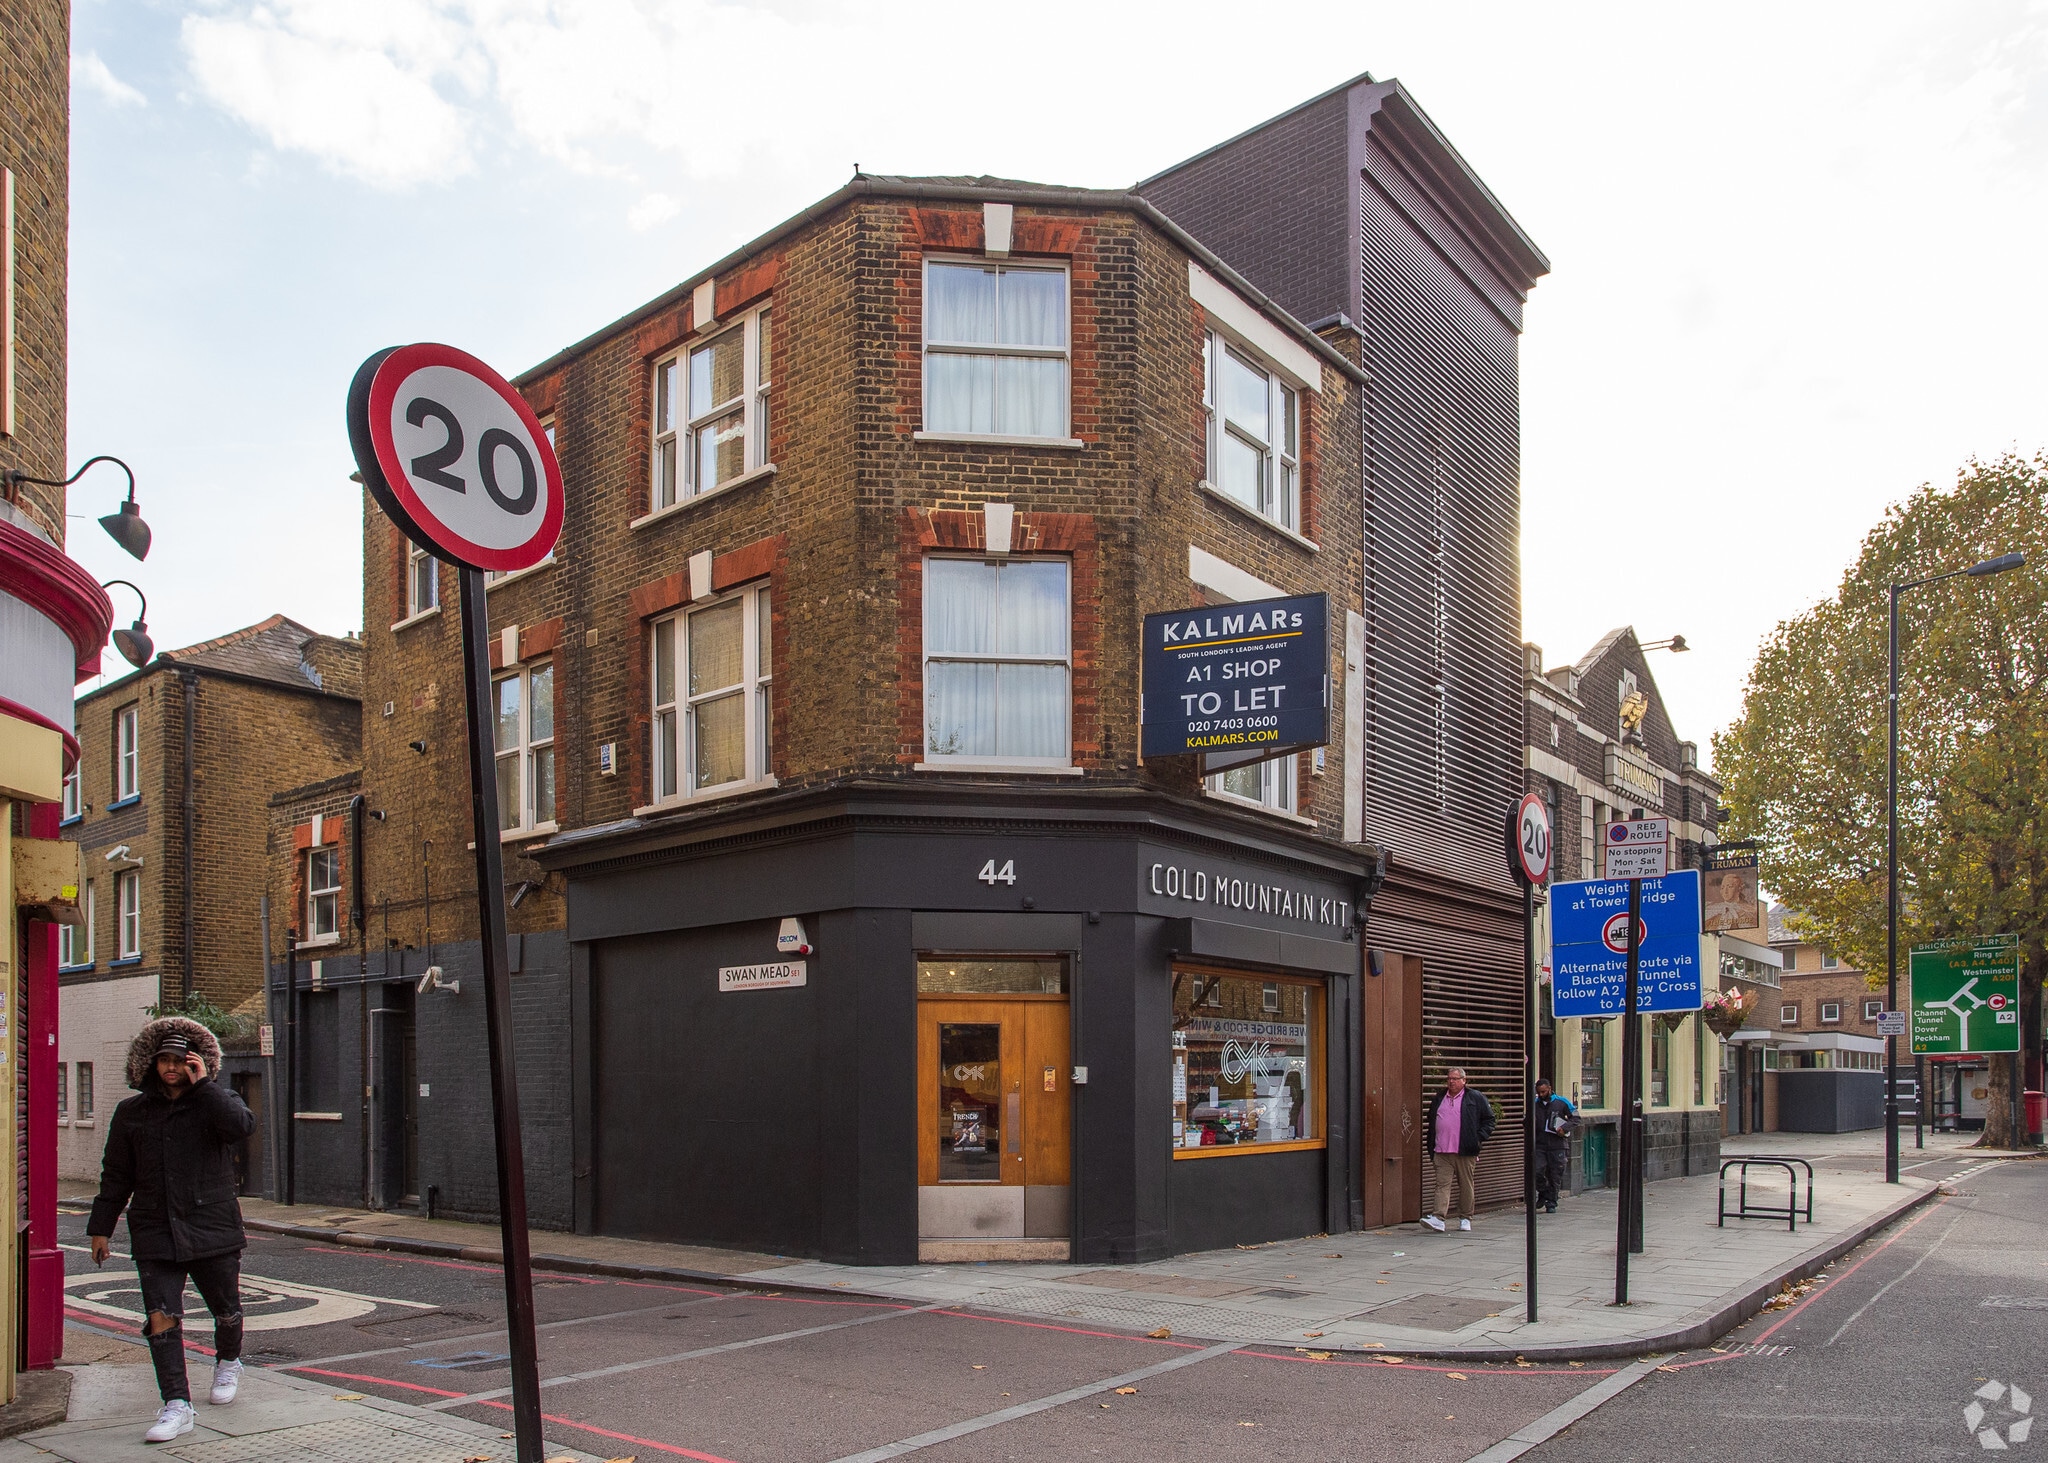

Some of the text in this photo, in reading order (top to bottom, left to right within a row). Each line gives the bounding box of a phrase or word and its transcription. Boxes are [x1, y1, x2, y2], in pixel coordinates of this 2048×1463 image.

[406, 397, 538, 516] 20
[1178, 641, 1288, 660] SOUTH LONDON'S LEADING AGENT
[1186, 658, 1281, 683] A1 SHOP
[1180, 685, 1286, 716] TO LET
[1188, 715, 1278, 733] 020 7403 0600
[1186, 729, 1279, 748] KALMARS.COM
[1630, 831, 1663, 840] ROUTE
[1636, 823, 1657, 831] RED
[1523, 818, 1546, 860] 20
[1624, 847, 1662, 856] stopping
[1614, 859, 1633, 867] Mon
[1640, 857, 1656, 865] Sat
[1710, 857, 1752, 870] TRUMAN
[978, 858, 1017, 886] 44
[1151, 863, 1348, 927] COLD MOUNTAIN KIT
[1584, 878, 1663, 896] Weight mit
[1572, 892, 1676, 910] at Tower ridge
[1974, 951, 1993, 959] Ring
[726, 968, 756, 982] SWAN
[760, 965, 790, 979] MEAD
[1560, 955, 1692, 975] Alternative oute via
[1962, 967, 2015, 976] Westminster
[1572, 968, 1681, 986] Blackwal Tunnel
[1992, 974, 2015, 982] A201
[1557, 986, 1596, 999] follow
[1658, 981, 1697, 993] Cross
[1600, 995, 1652, 1009] to A02
[1914, 1009, 1947, 1017] Channel
[1917, 1016, 1944, 1024] Tunnel
[1999, 1013, 2013, 1021] A2
